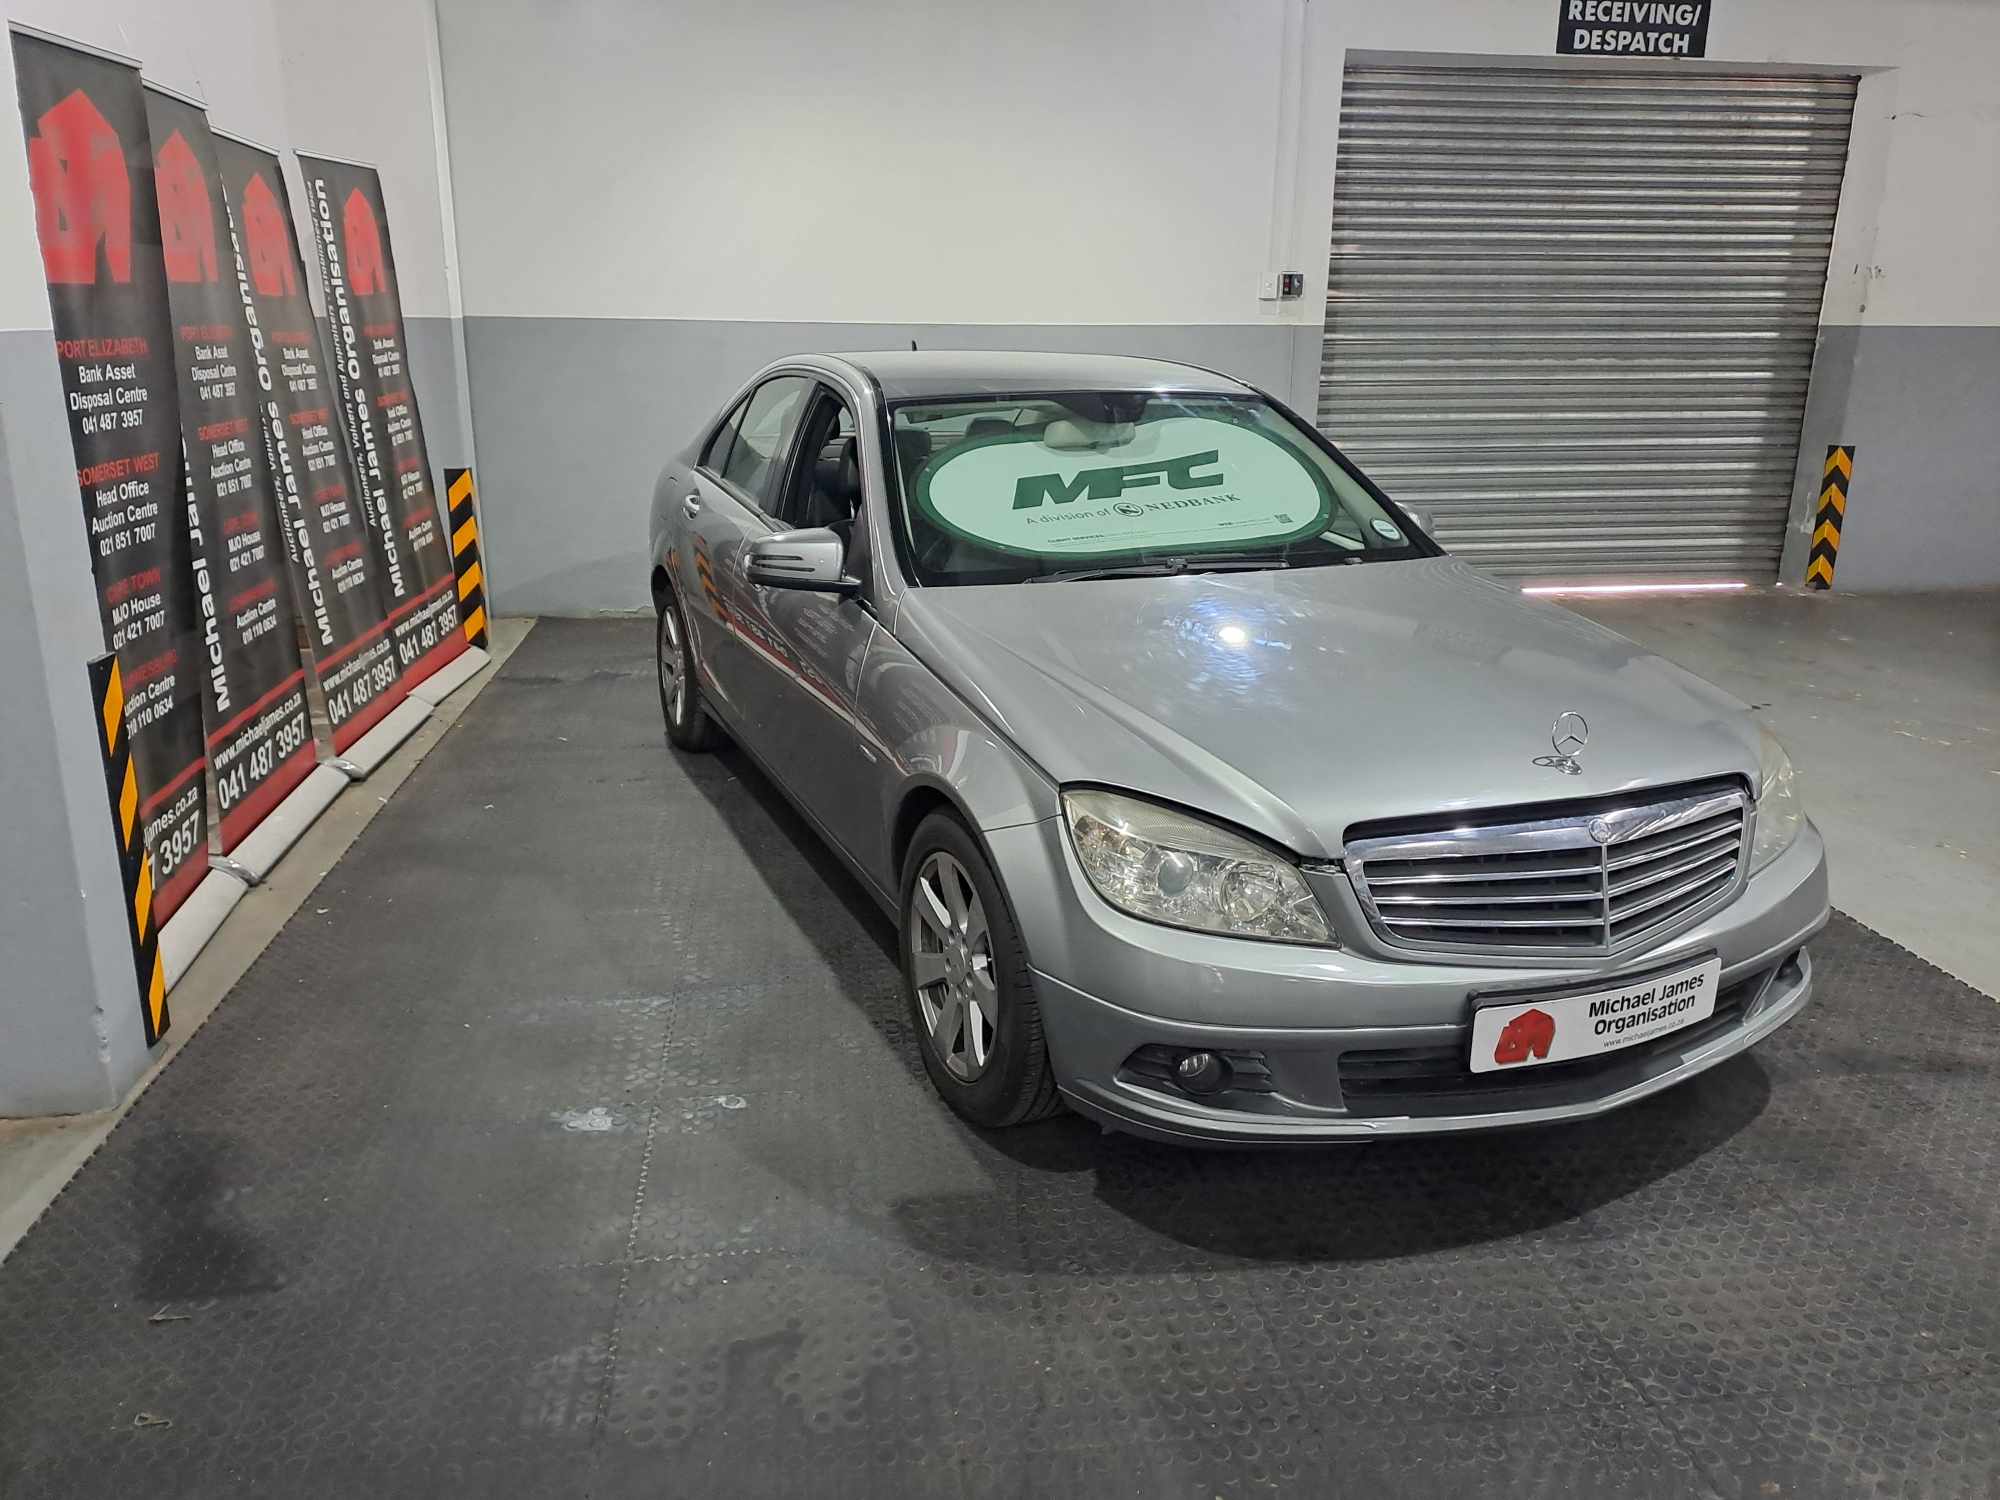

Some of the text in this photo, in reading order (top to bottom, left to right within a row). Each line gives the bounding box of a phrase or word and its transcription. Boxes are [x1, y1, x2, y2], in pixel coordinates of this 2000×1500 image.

[1567, 0, 1702, 27] RECEIVING/
[1573, 28, 1690, 54] DESPATCH
[219, 172, 272, 391] Organisa
[78, 362, 136, 384] Bank Asset
[314, 179, 406, 598] Michael James Organisation
[69, 385, 149, 412] Disposal Centre
[82, 409, 143, 434] 041 487 3957
[133, 452, 161, 474] WEST
[267, 401, 302, 510] James
[96, 480, 149, 508] Head Office
[1012, 449, 1224, 510] MFC
[91, 501, 158, 535] Auction Centre
[1026, 492, 1241, 525] A division of NEDBANK
[100, 523, 156, 557] 021 851 7007
[292, 518, 335, 647] Michael
[112, 593, 161, 626] MJO House
[113, 610, 165, 650] 021 421 7007
[192, 557, 231, 713] Michael
[399, 604, 458, 665] 041 487 3957
[124, 675, 176, 717] uction Centre
[328, 655, 397, 725] 041 487 3957
[137, 707, 152, 729] 110
[153, 694, 174, 719] 0634
[213, 692, 302, 771] www.michaeljames.co.za
[218, 712, 307, 810] 041 487 3957
[160, 809, 200, 875] 3957
[1588, 973, 1705, 1018] Michael James
[1594, 995, 1696, 1035] Organisation
